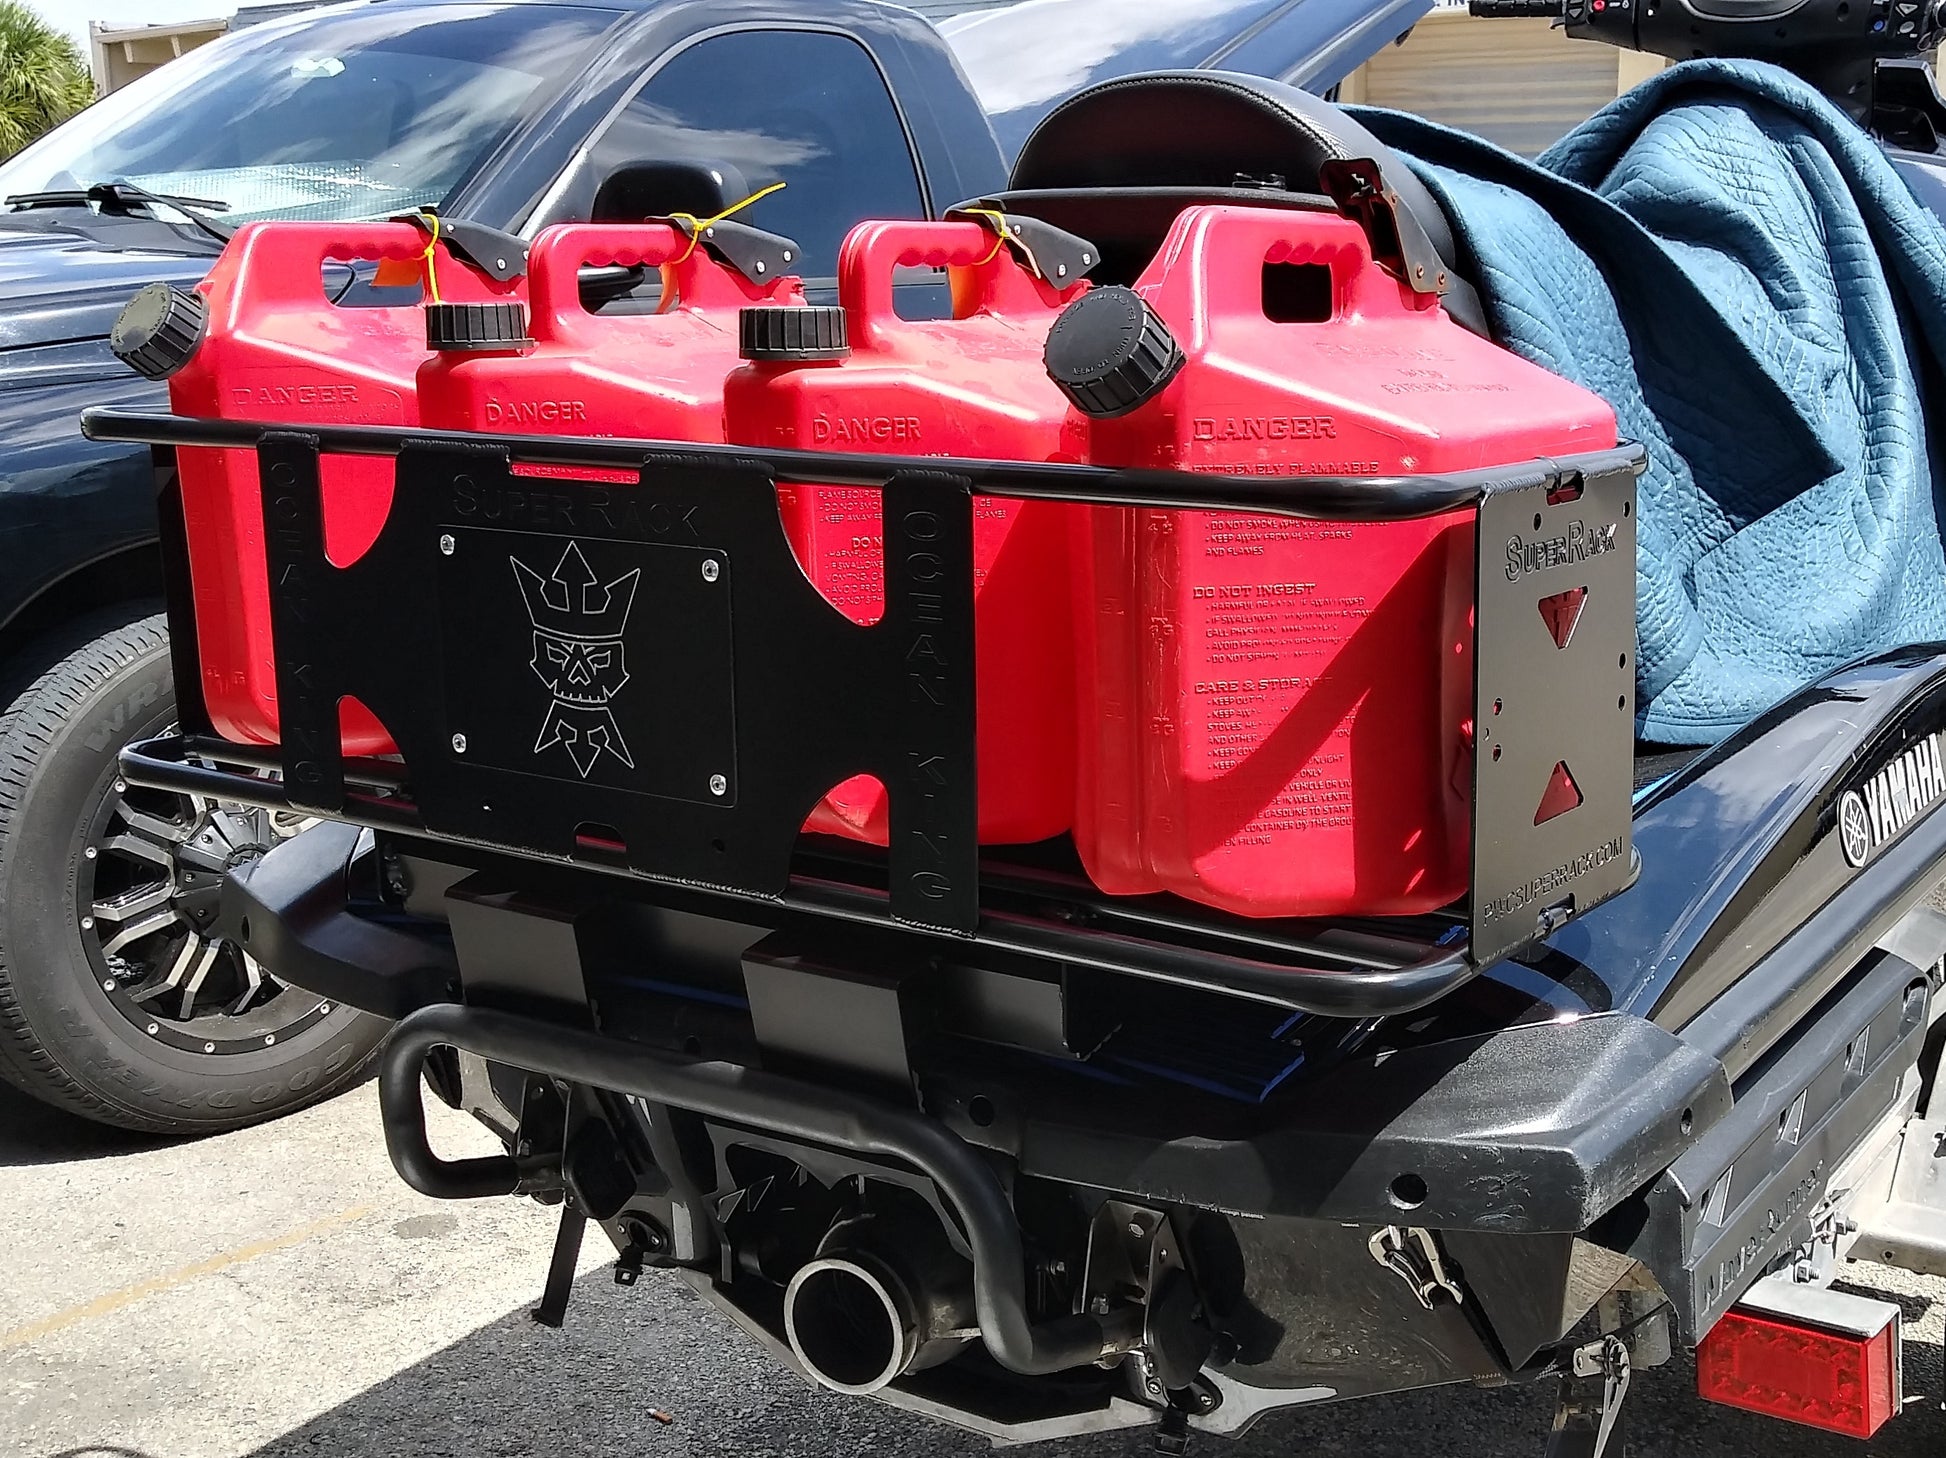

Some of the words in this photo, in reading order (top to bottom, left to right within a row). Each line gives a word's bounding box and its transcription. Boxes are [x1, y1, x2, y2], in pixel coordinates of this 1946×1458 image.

[485, 400, 587, 424] DANGER
[813, 416, 922, 442] DANGER
[1194, 416, 1337, 441] DANGER
[1289, 461, 1379, 475] FLAMMABLE
[1193, 586, 1216, 599] DO
[1219, 585, 1253, 599] NOT
[1256, 583, 1316, 598] INGEST
[1195, 681, 1239, 694] CARE
[1242, 680, 1255, 692] &
[1863, 733, 1946, 846] YAMAHA
